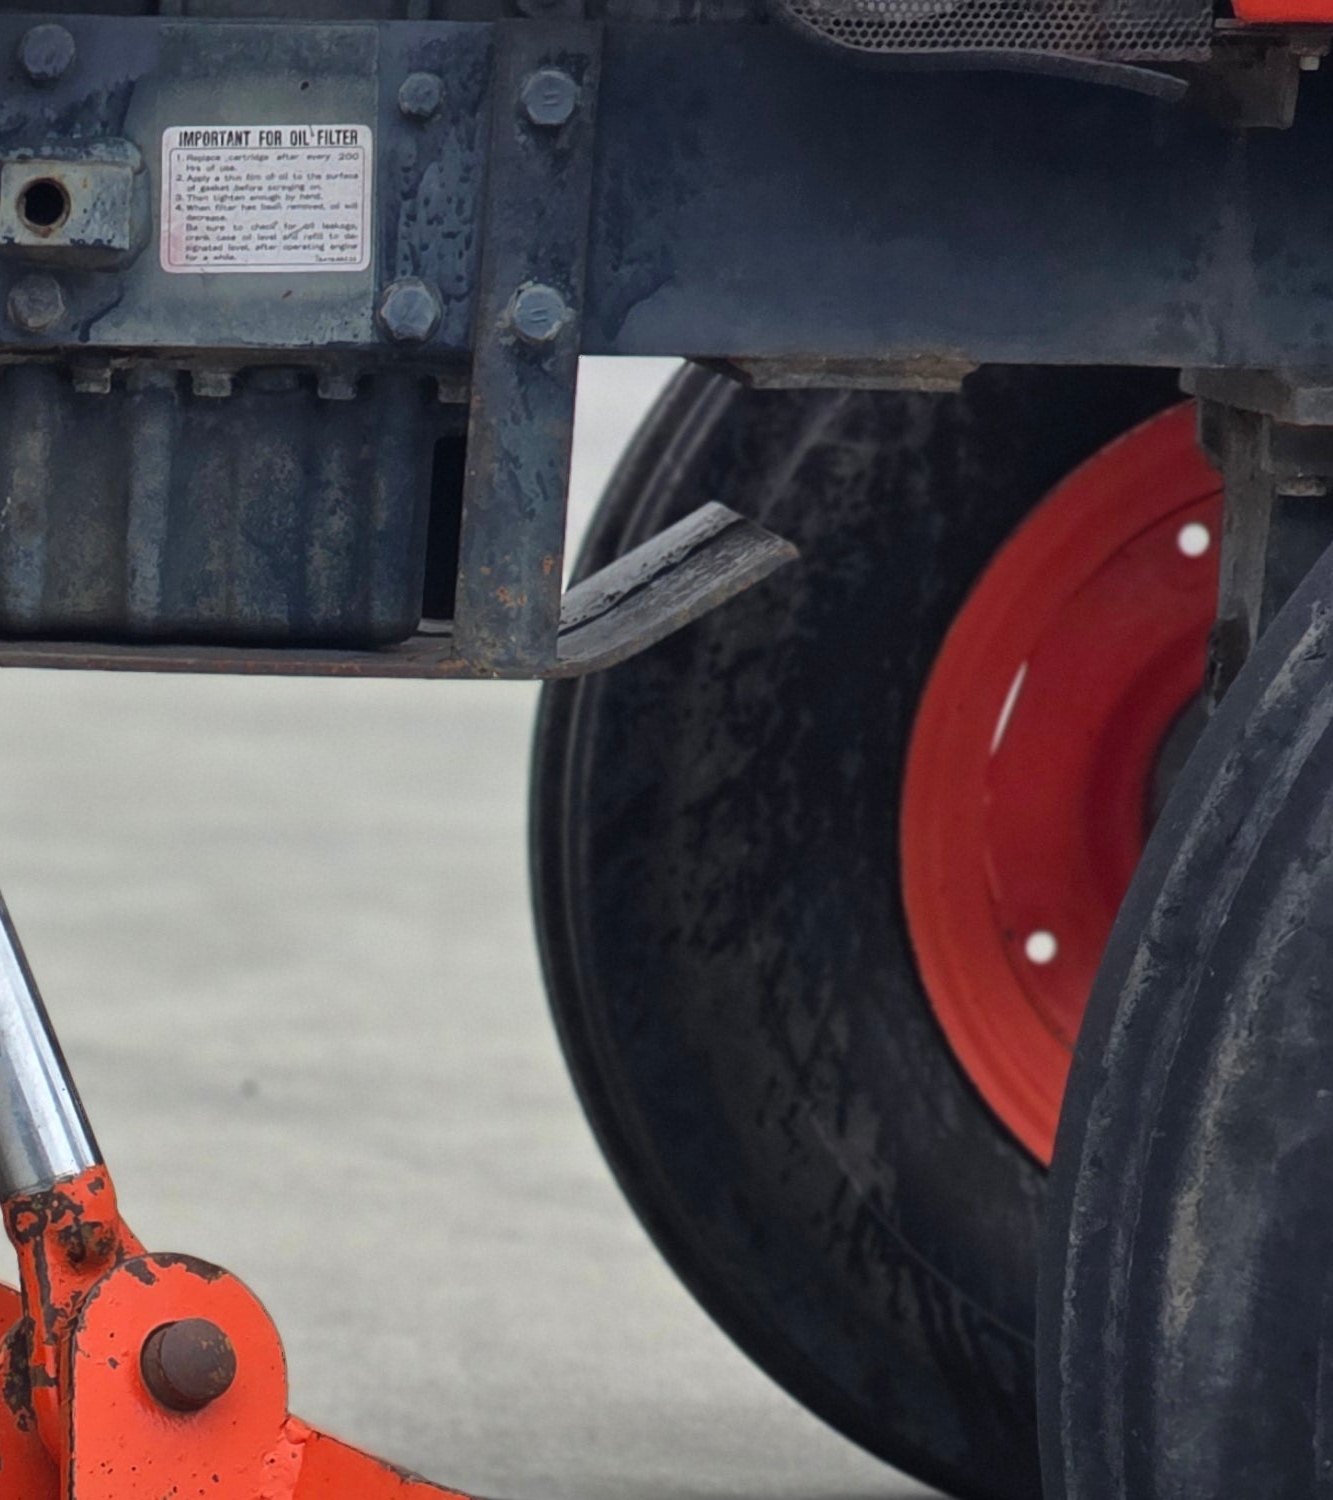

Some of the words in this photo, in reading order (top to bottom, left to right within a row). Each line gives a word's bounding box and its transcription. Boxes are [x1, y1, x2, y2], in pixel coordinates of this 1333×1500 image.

[178, 130, 251, 147] IMPORTANT
[259, 130, 282, 147] FOR
[290, 129, 310, 147] OIL
[317, 129, 358, 146] FILTER
[186, 154, 221, 163] Replace
[276, 152, 299, 161] after
[306, 153, 331, 162] every
[338, 152, 359, 161] 200
[186, 174, 210, 183] Apply
[306, 172, 322, 180] the
[326, 172, 359, 180] surface
